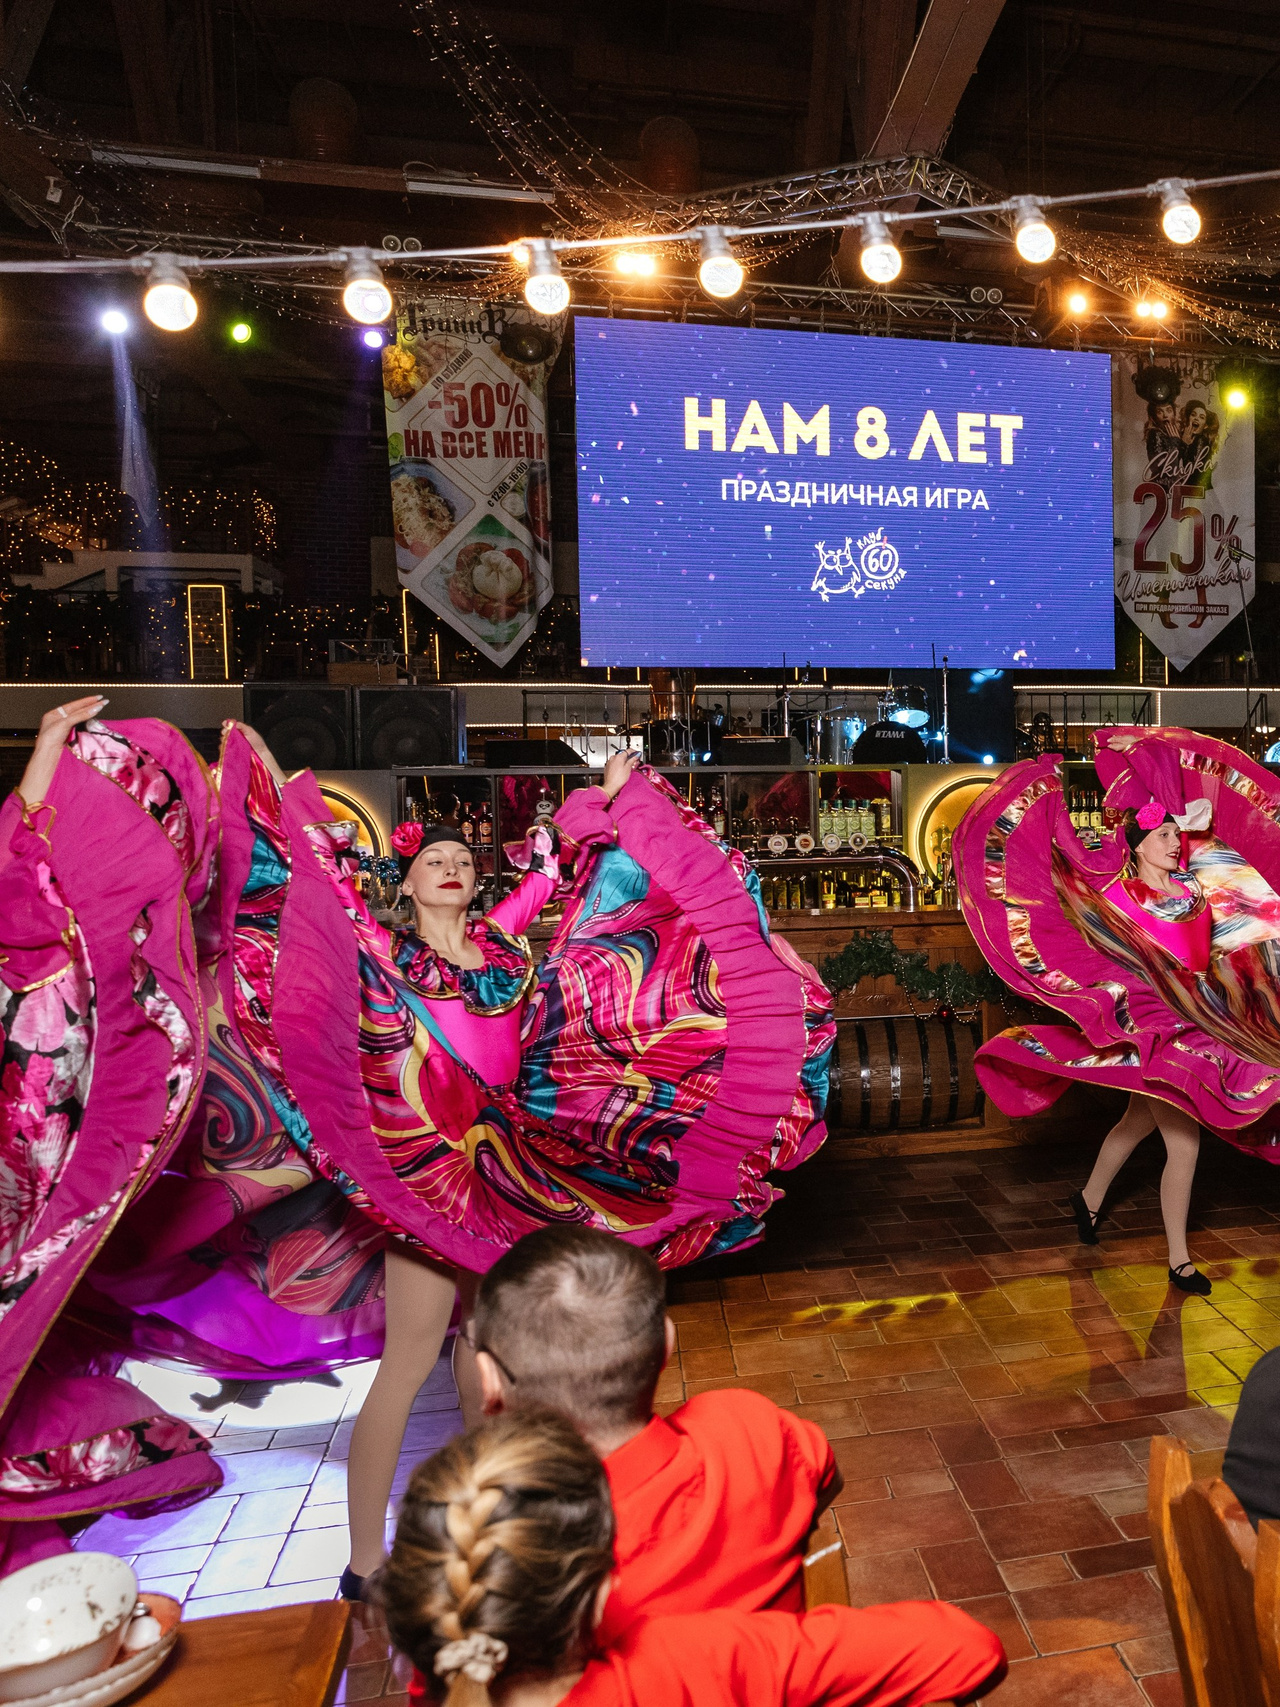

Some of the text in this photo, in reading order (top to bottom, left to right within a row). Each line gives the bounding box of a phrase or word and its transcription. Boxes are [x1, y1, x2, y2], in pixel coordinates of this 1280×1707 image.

[431, 348, 473, 390] ПО БУДНЯМ
[428, 382, 528, 429] -50%
[404, 429, 437, 458] НА
[441, 430, 489, 459] ВСЕ
[684, 397, 1023, 465] НАМ 8 ЛЕТ
[721, 479, 990, 510] ПРАЗДНИЧНАЯ ИГРА
[868, 548, 893, 573] 60
[1135, 603, 1228, 614] ПРИ ПРЕДВАРИТЕЛЬНОМ ЗАКАЗЕ
[880, 730, 905, 739] TAMA
